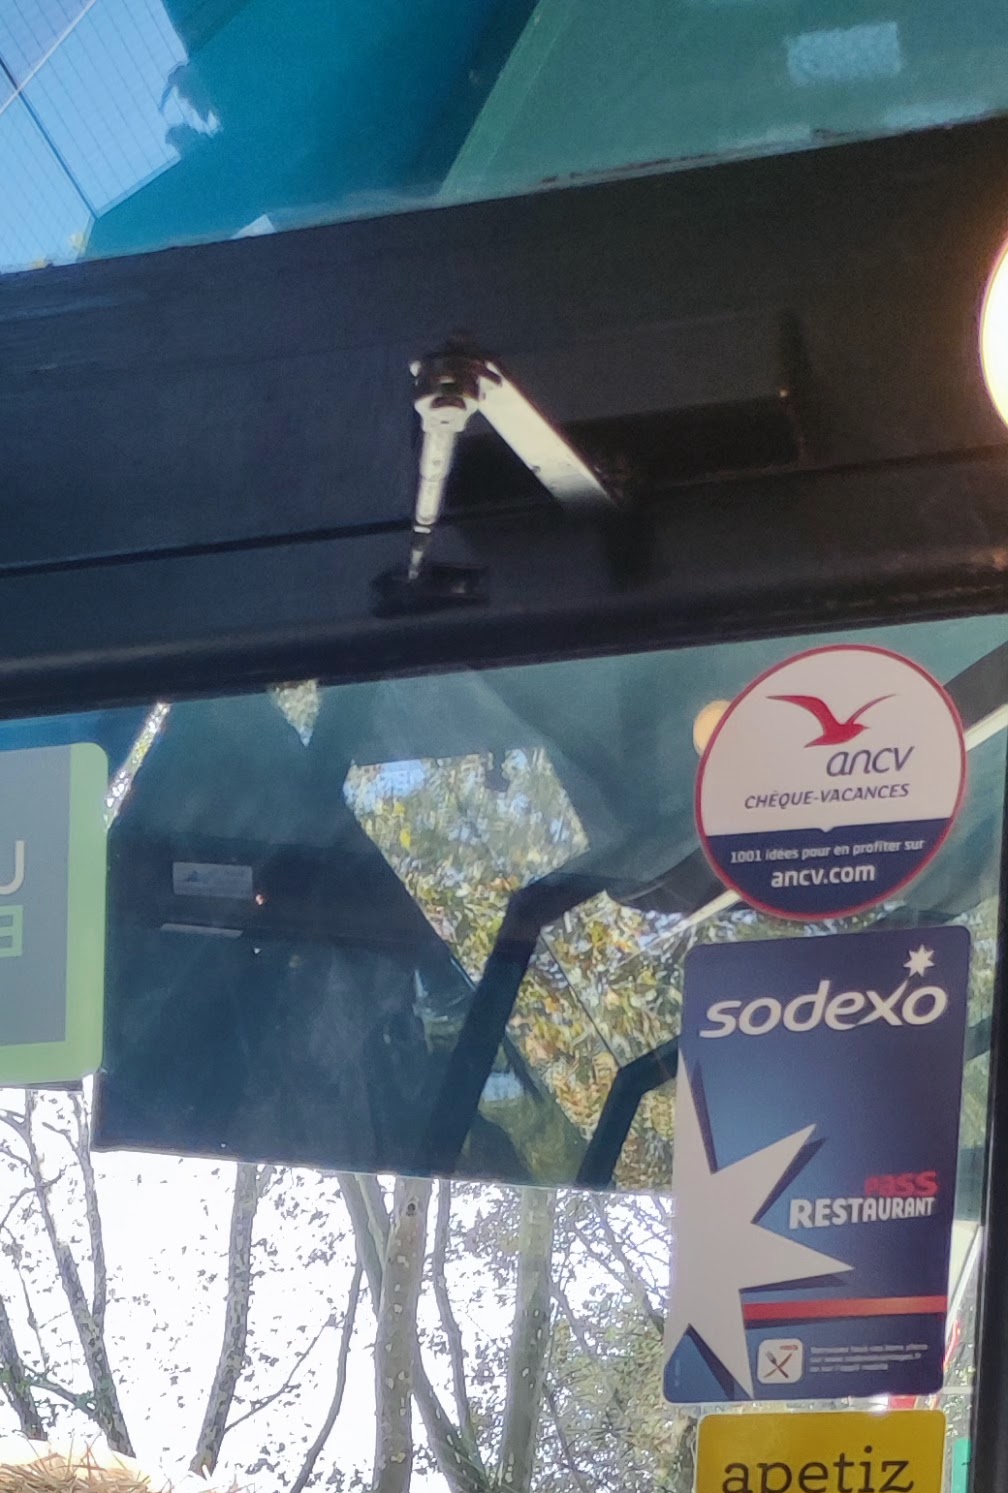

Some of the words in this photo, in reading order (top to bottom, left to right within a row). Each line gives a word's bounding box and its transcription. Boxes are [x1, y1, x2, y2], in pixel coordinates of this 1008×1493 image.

[825, 746, 915, 777] ancv
[730, 849, 761, 863] 1001
[765, 847, 799, 862] idées
[802, 847, 830, 861] pour
[833, 845, 849, 856] en
[853, 840, 901, 857] profiter
[904, 839, 926, 851] sur
[770, 864, 876, 888] ancv.com
[698, 977, 948, 1039] sodexo
[789, 1196, 936, 1230] RESTAURANT
